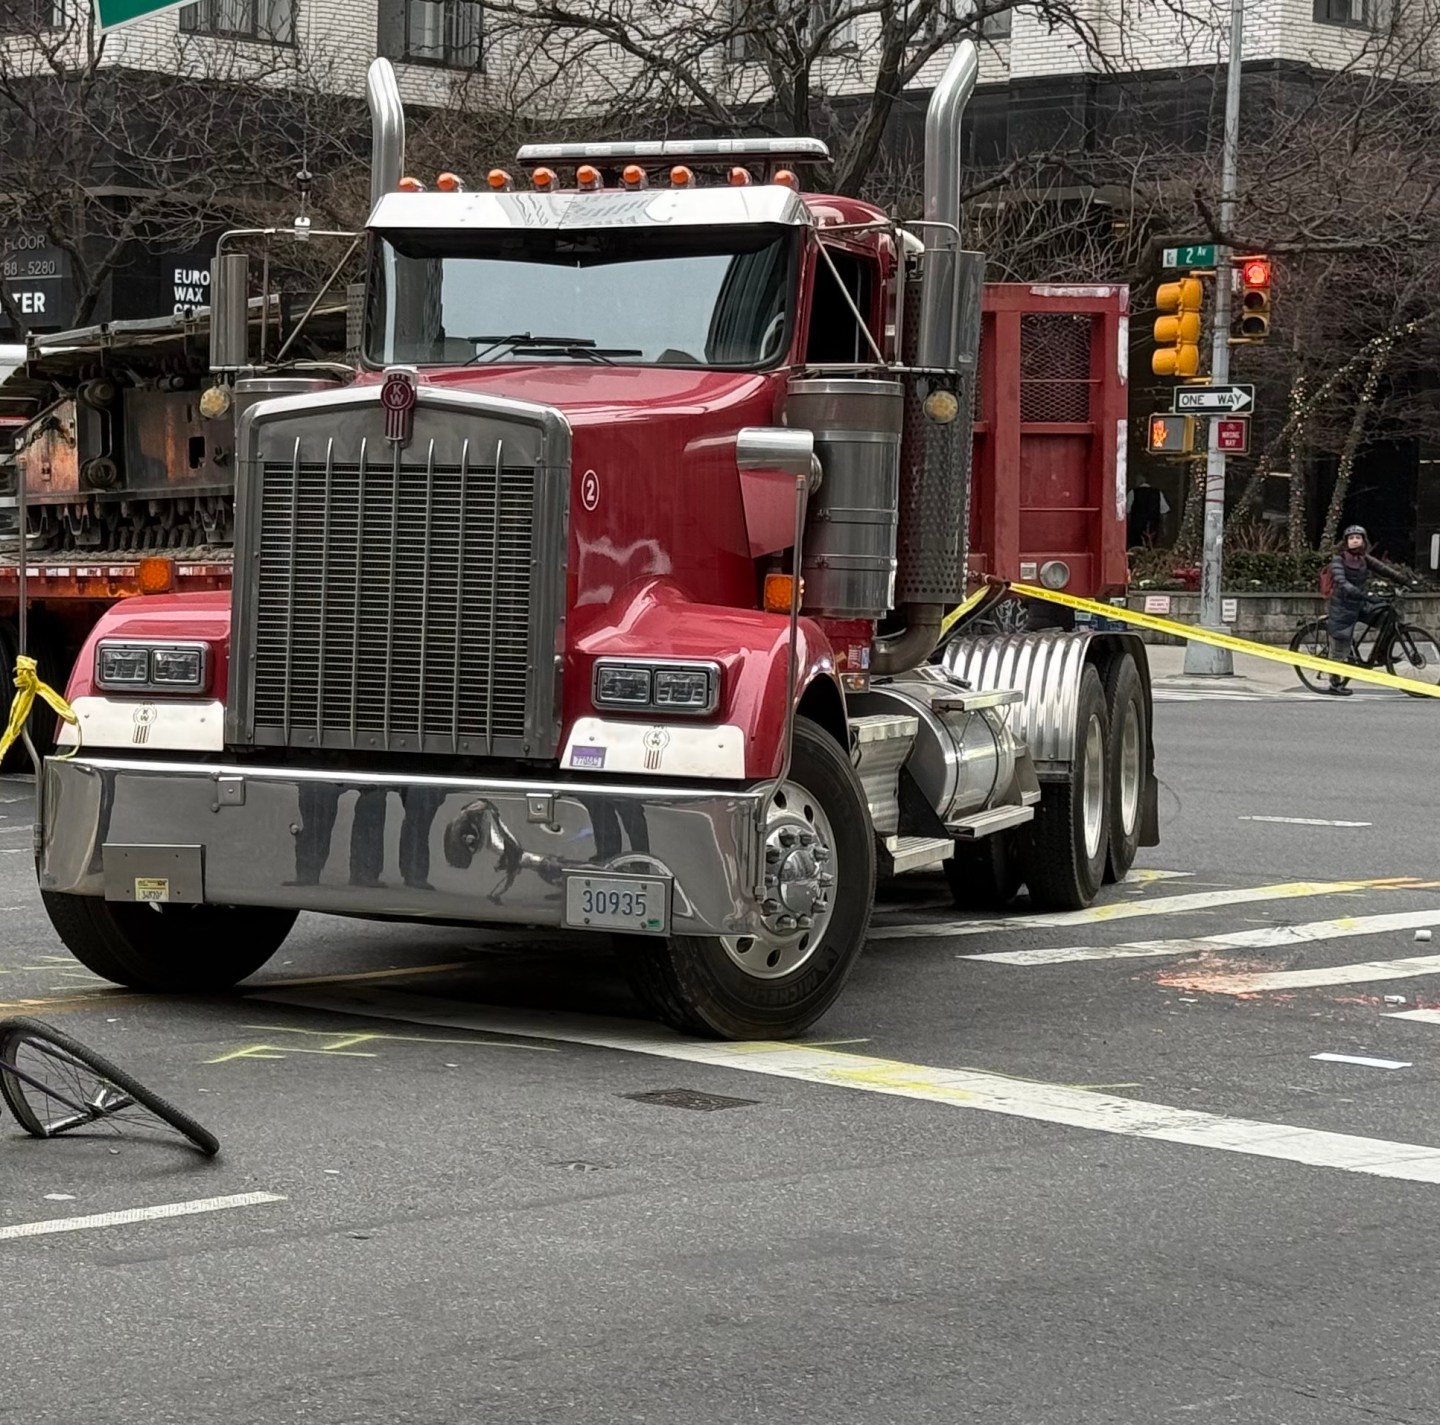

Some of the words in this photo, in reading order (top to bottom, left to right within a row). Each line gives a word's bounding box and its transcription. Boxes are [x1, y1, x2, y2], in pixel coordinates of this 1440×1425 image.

[1186, 249, 1193, 263] 2
[1197, 248, 1207, 256] Av
[28, 261, 55, 275] 5280
[174, 269, 210, 285] EURO
[174, 286, 203, 302] WAX
[1181, 395, 1205, 406] ONE
[1217, 394, 1243, 405] WAY
[586, 480, 595, 501] 2
[582, 890, 647, 917] 30935
